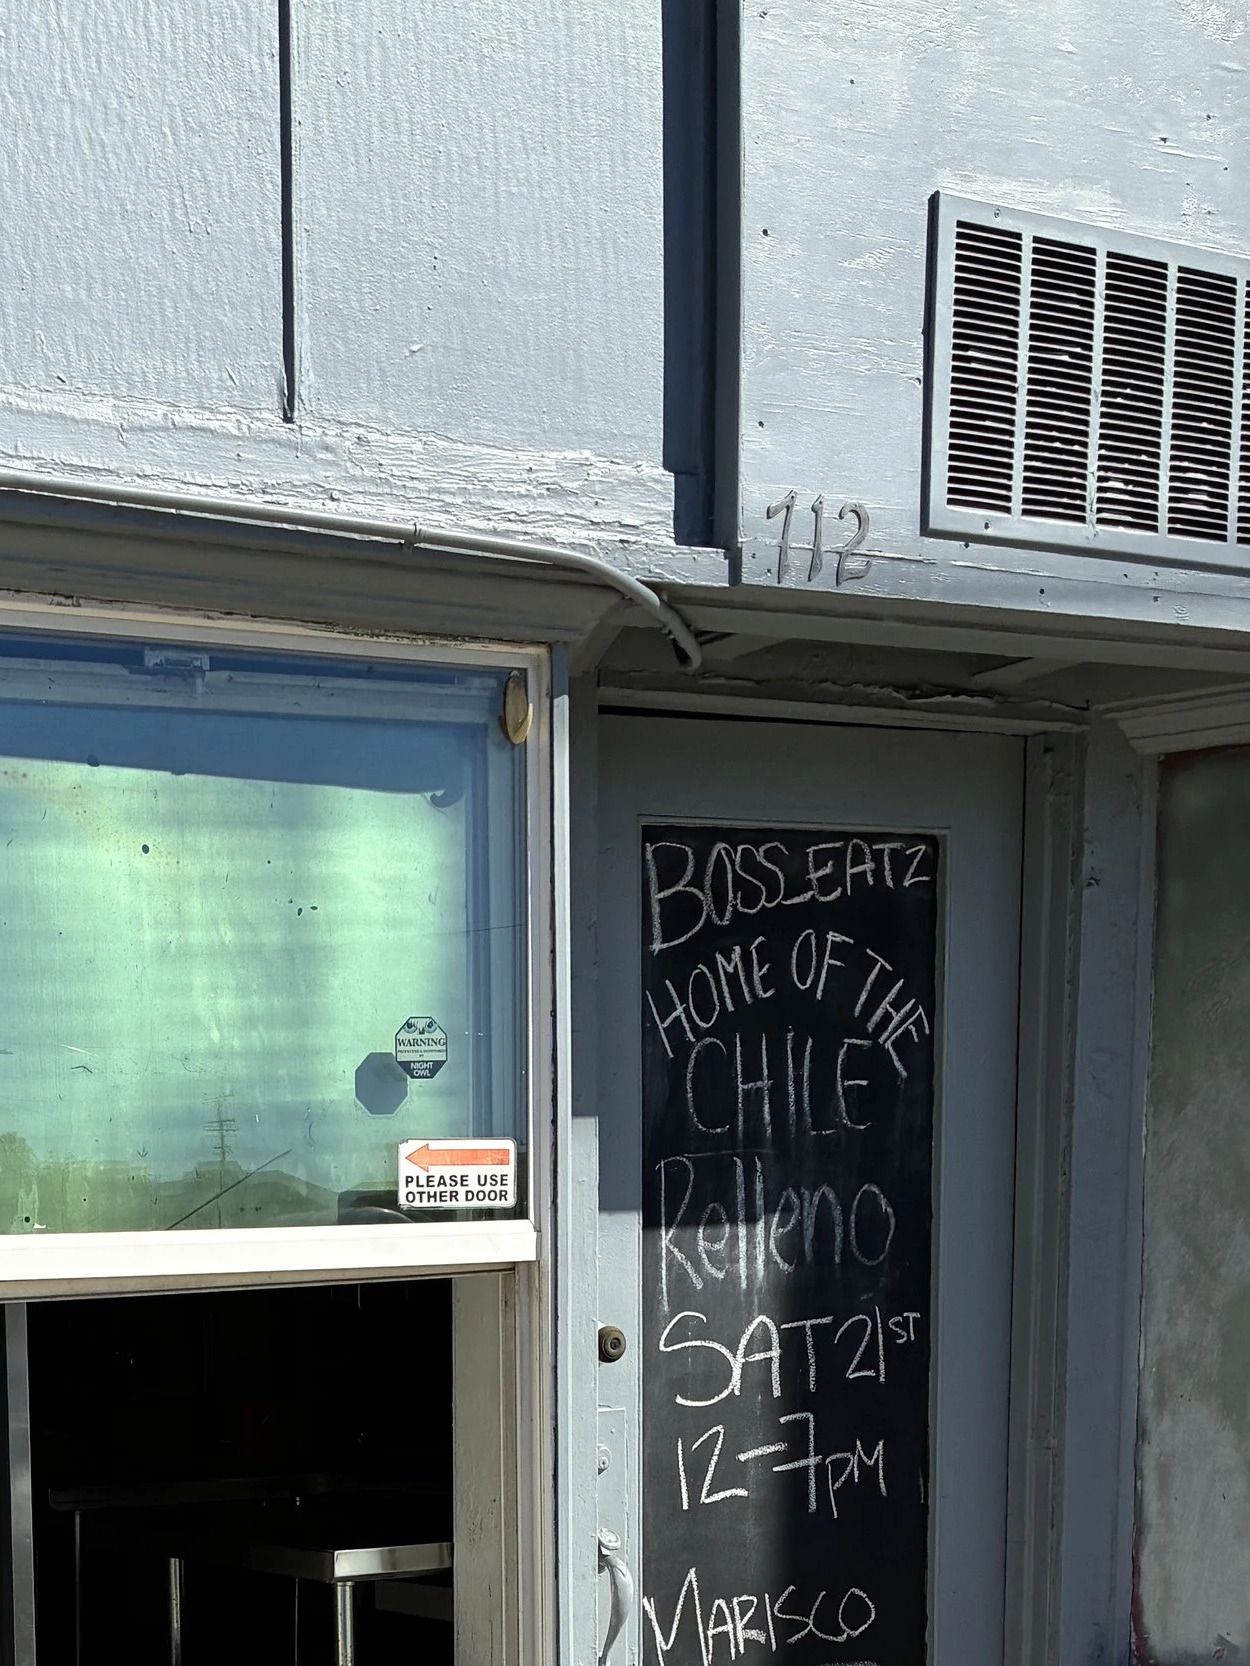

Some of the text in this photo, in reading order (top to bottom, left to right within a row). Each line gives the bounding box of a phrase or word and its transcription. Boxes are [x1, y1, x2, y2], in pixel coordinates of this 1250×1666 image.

[766, 489, 872, 586] 712
[645, 929, 931, 1079] HOME OF THE
[397, 1037, 446, 1047] WARNING
[410, 1062, 434, 1070] NIGHT
[413, 1069, 431, 1077] OWL
[686, 1026, 873, 1140] CHILE
[405, 1174, 508, 1188] PLEASE USE
[405, 1189, 508, 1203] OTHER DOOR
[656, 1156, 897, 1310] Relleno
[658, 1311, 833, 1407] SAT
